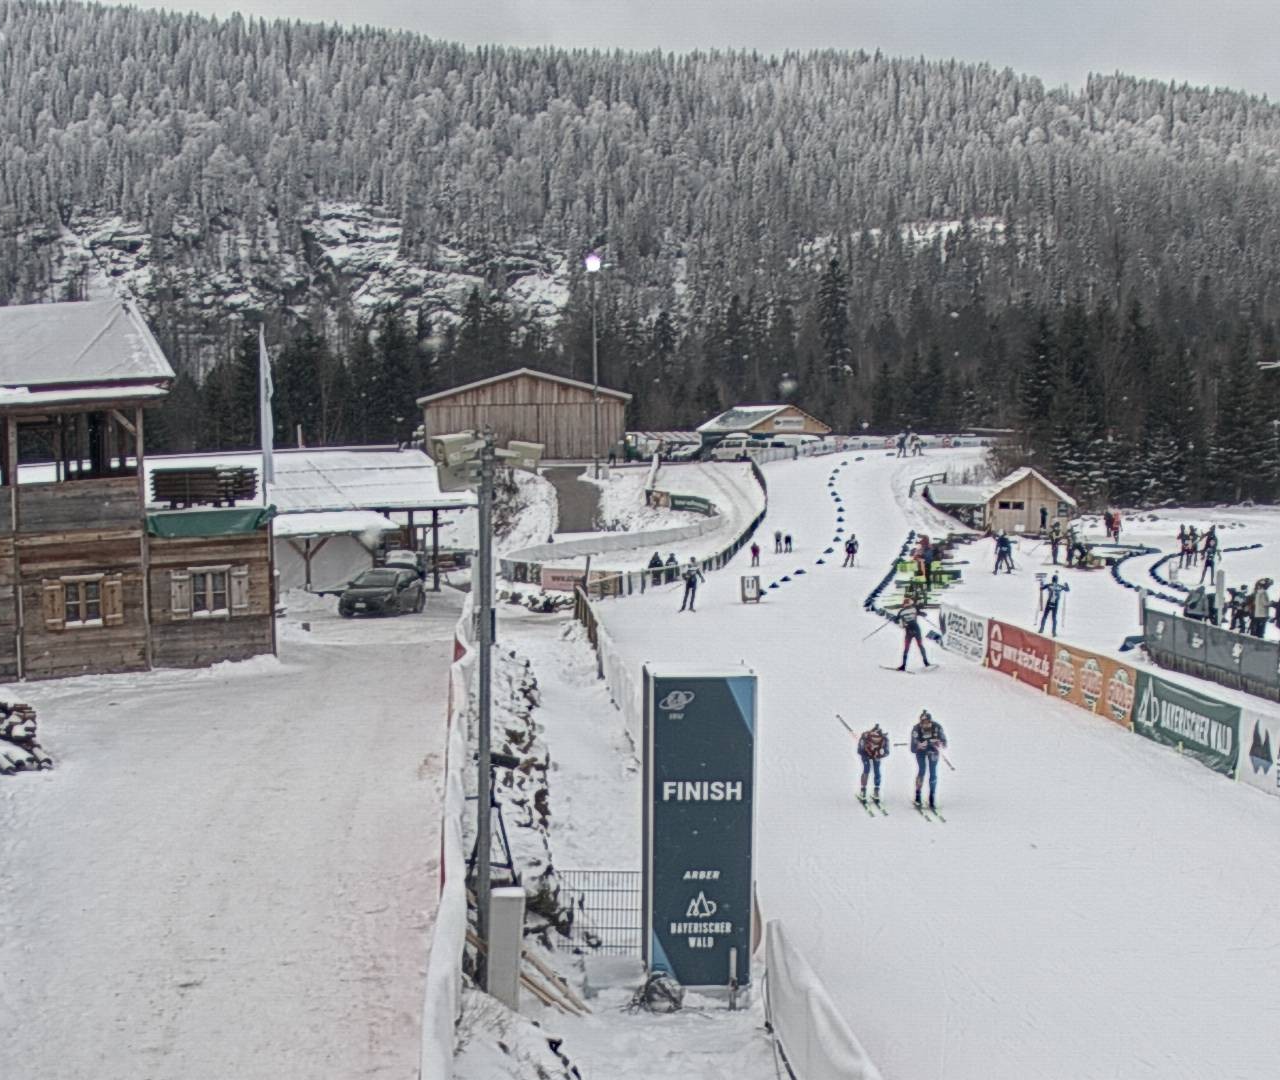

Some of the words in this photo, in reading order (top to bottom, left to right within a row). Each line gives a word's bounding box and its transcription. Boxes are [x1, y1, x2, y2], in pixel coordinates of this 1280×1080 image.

[1160, 700, 1210, 746] BAYERISCHER
[1210, 719, 1233, 756] WALD
[662, 781, 743, 801] FINISH
[670, 921, 732, 934] BAYERISCHER
[688, 936, 715, 948] WALD
